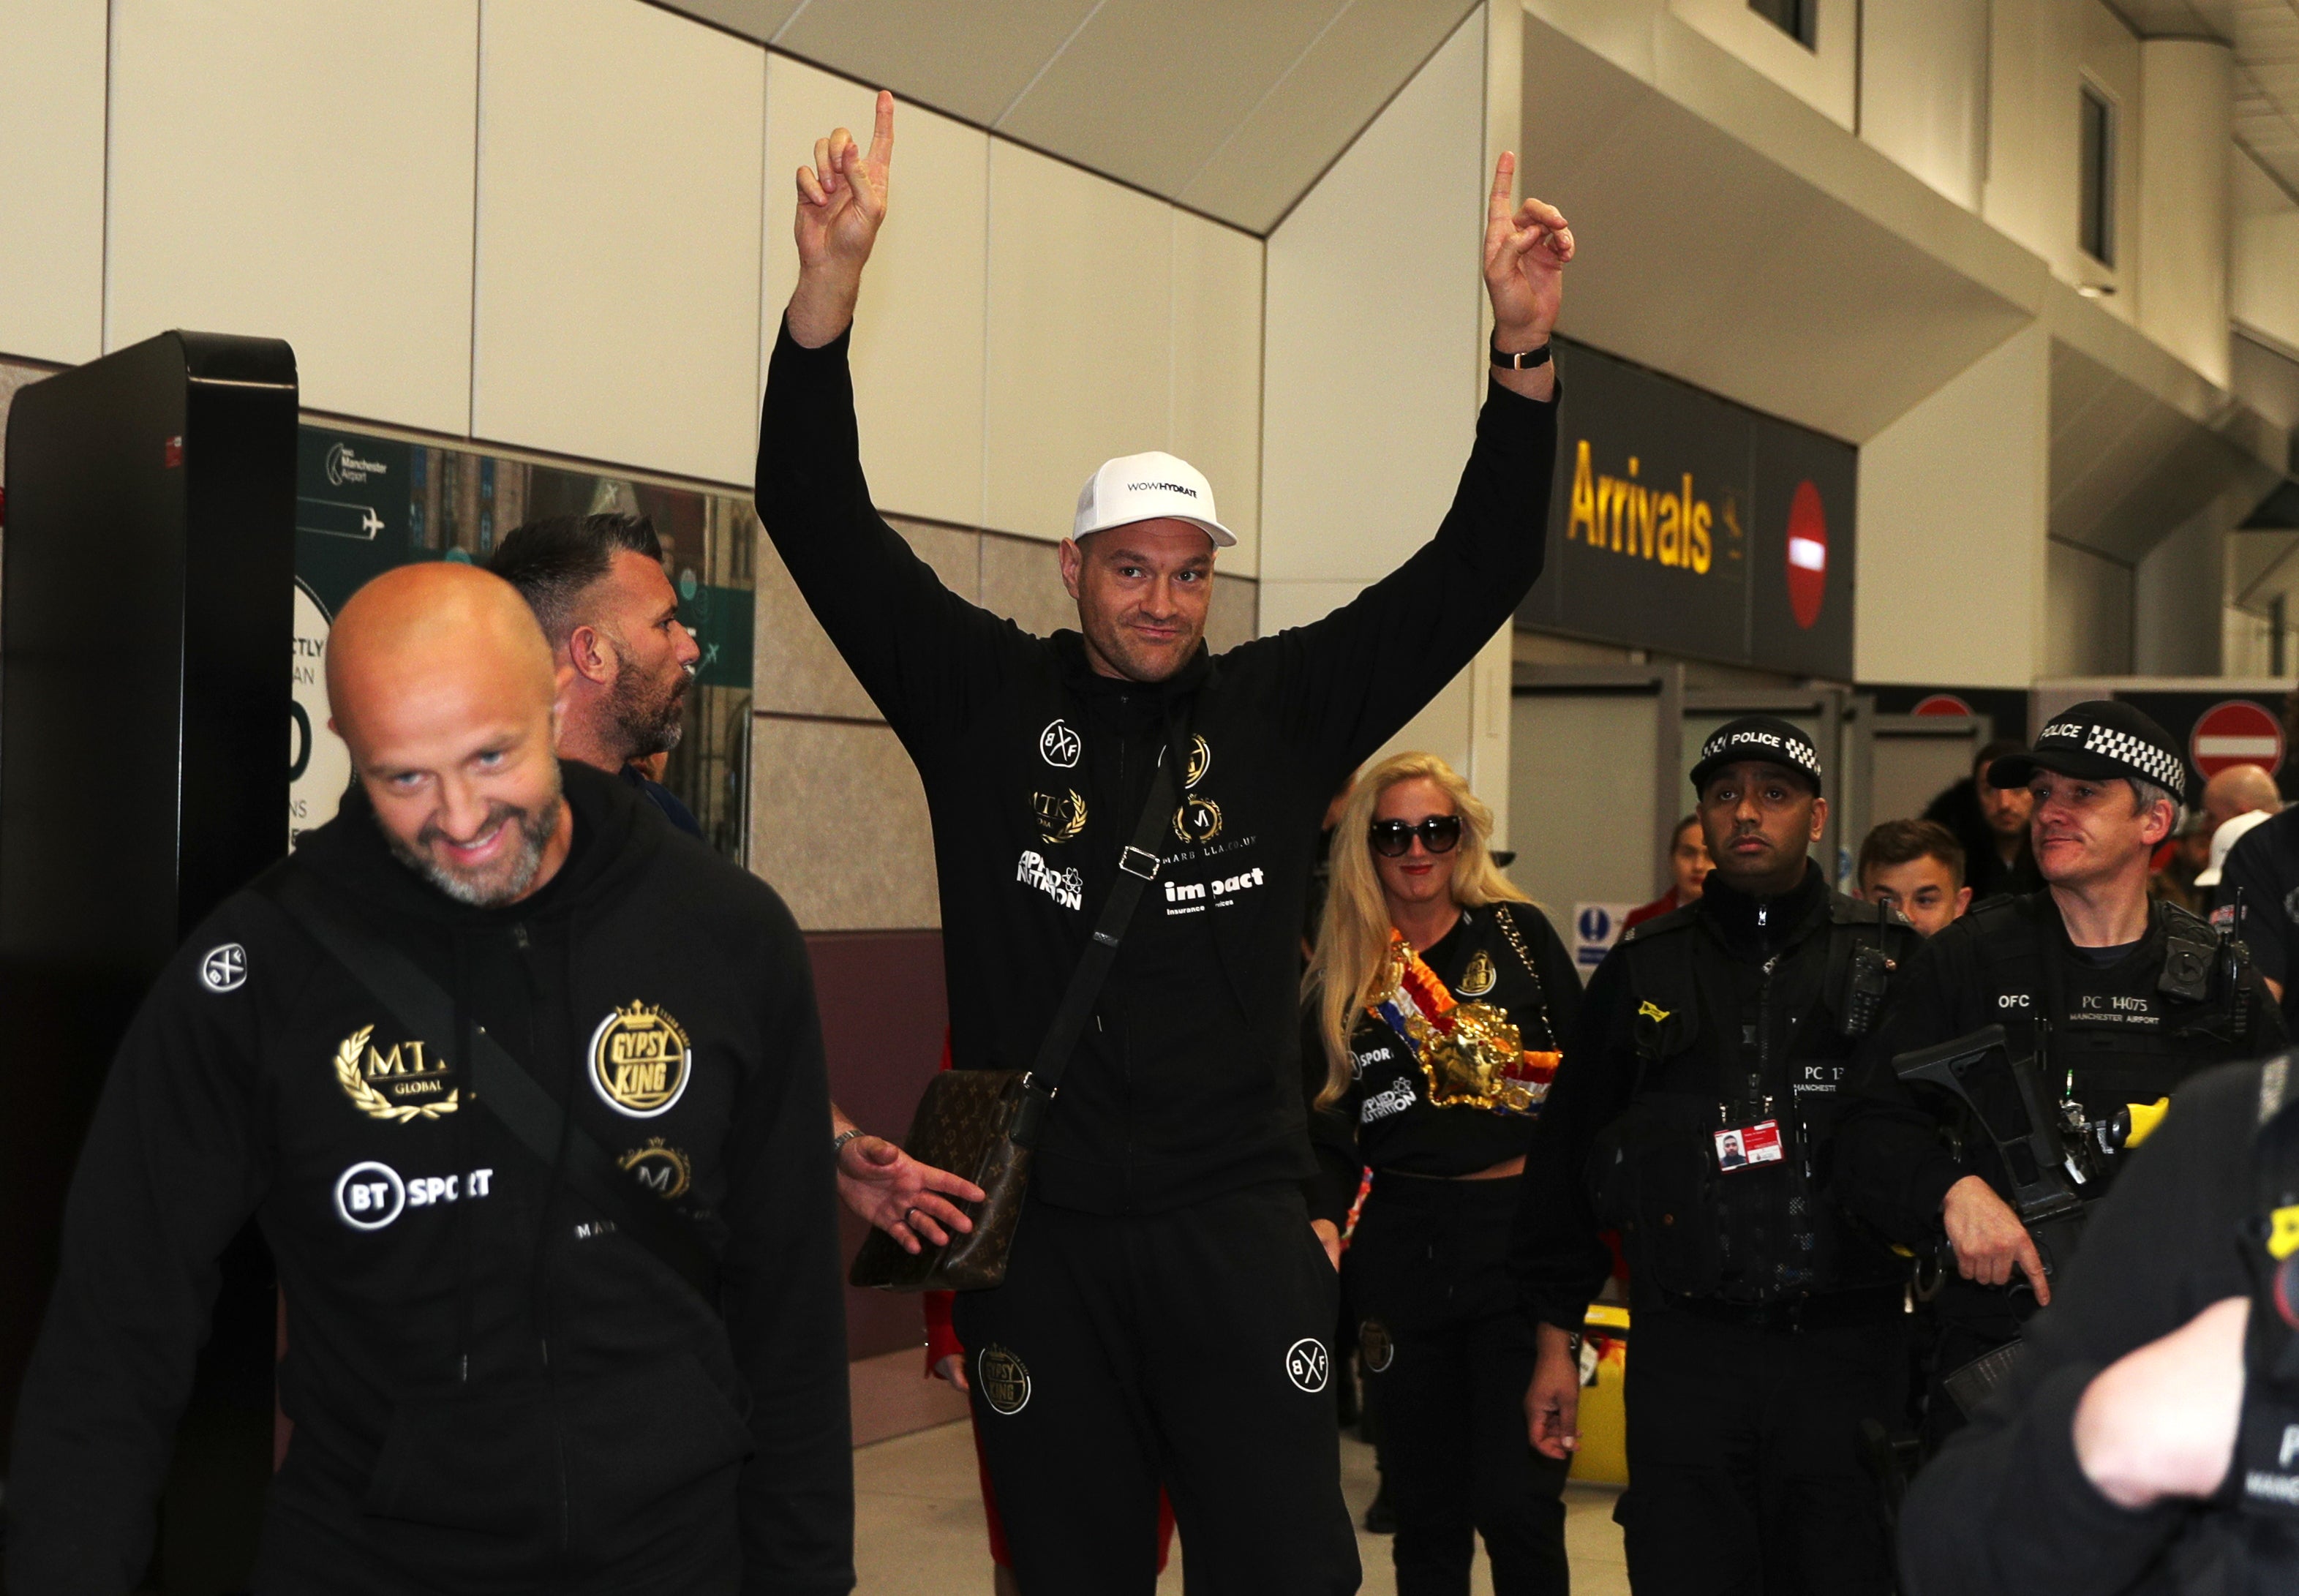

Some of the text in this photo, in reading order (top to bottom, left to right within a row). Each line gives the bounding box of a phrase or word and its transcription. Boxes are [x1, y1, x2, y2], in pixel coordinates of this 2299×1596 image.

[1127, 482, 1197, 499] WOWHYDRATE
[1567, 440, 1712, 574] Arrivals
[1731, 732, 1780, 748] POLICE
[1167, 906, 1205, 916] Insurance
[1998, 995, 2030, 1008] OFC
[2082, 995, 2148, 1012] PC 14075
[2069, 1012, 2160, 1024] MANCHESTER AIRPORT
[612, 1031, 670, 1063] GYPSY
[1360, 1047, 1394, 1066] SPOR
[615, 1063, 666, 1100] KING
[1805, 1066, 1823, 1080] PC
[394, 1079, 444, 1095] GLOBAL
[352, 1182, 388, 1211] BT
